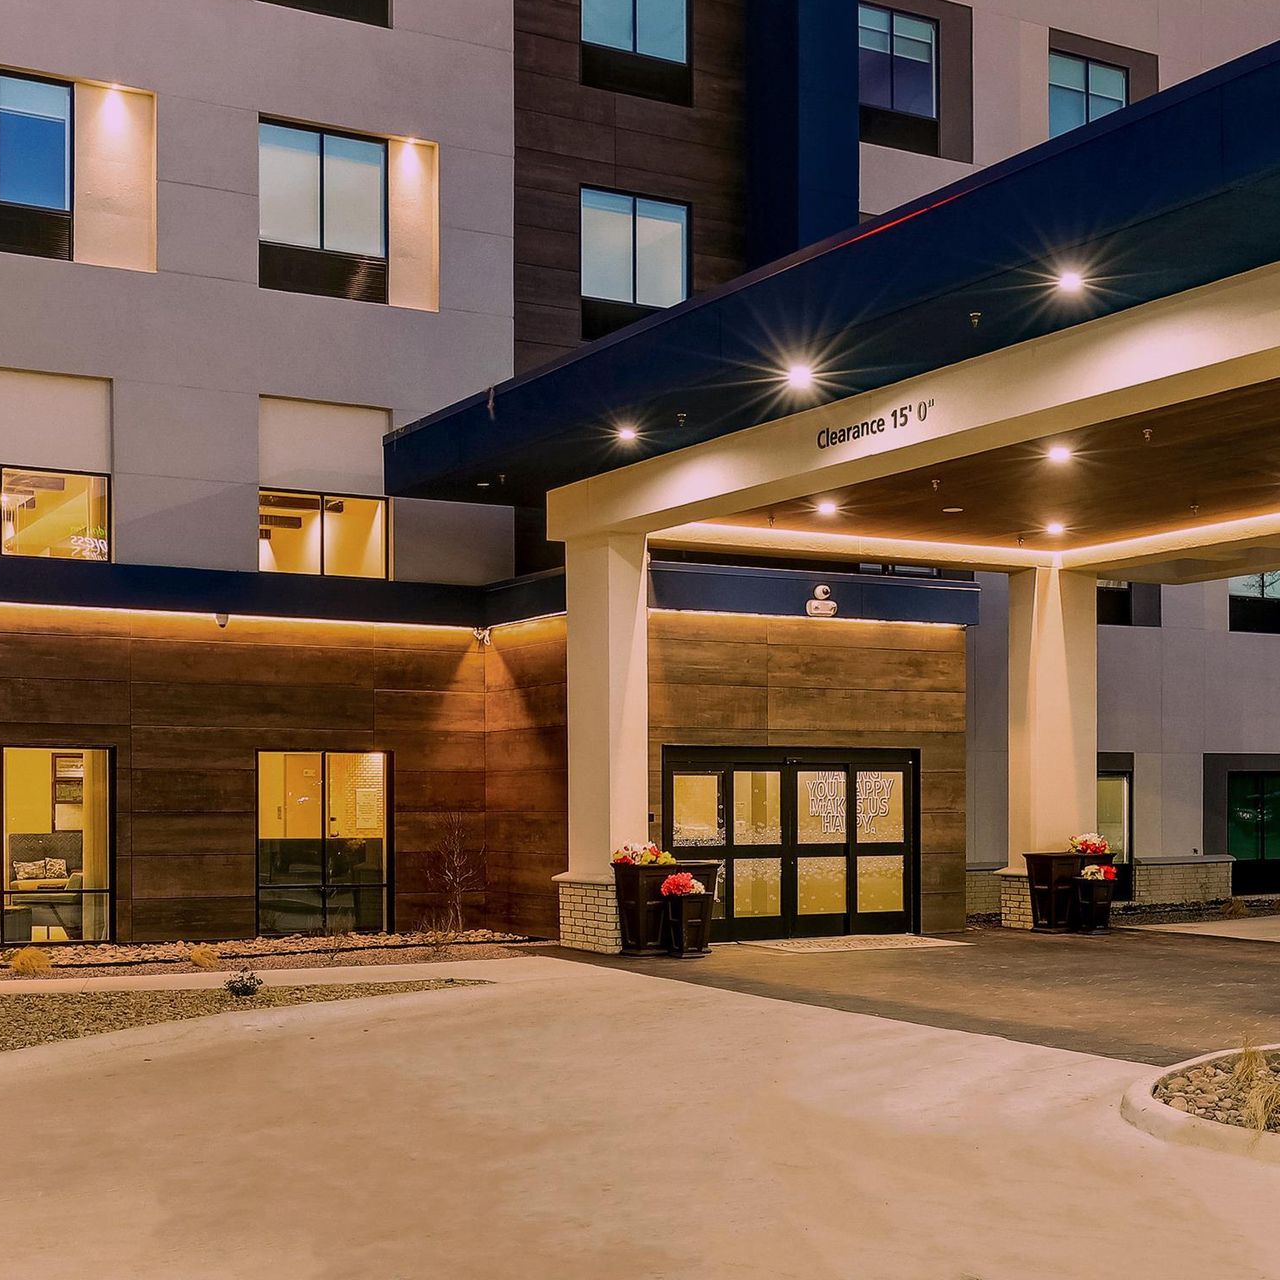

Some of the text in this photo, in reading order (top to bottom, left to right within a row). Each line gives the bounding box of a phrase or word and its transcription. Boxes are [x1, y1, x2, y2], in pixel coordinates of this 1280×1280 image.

[816, 417, 885, 449] Clearance
[890, 404, 913, 429] 15'
[806, 780, 837, 798] YOU
[810, 797, 889, 816] MAKS US
